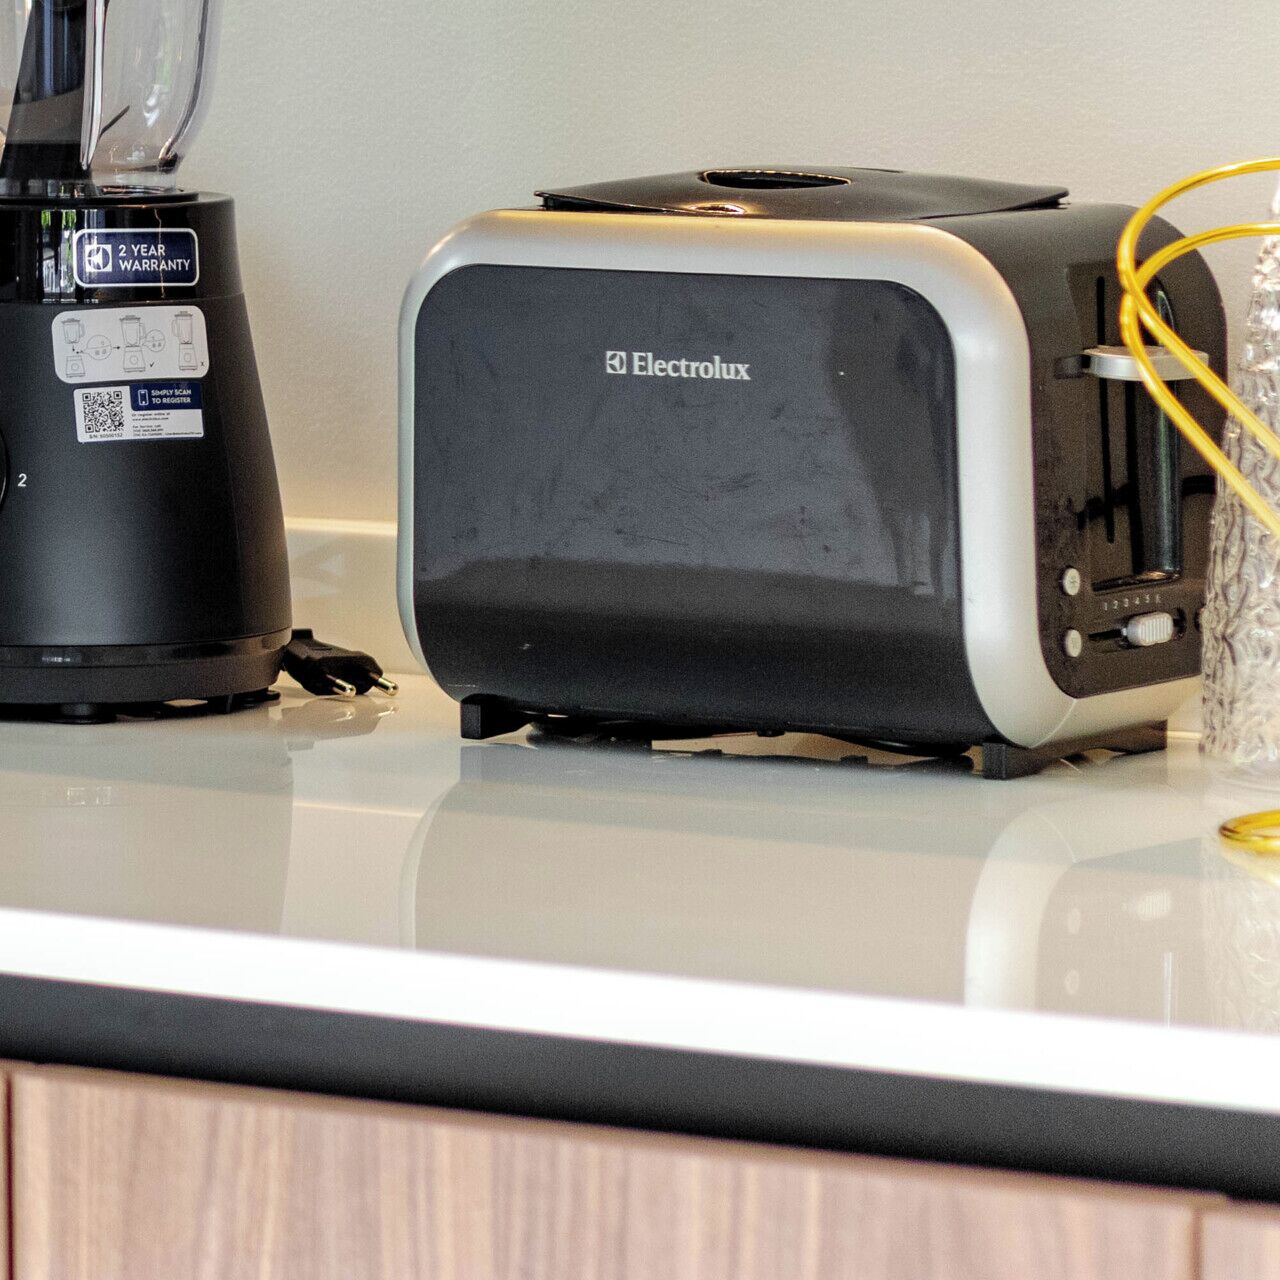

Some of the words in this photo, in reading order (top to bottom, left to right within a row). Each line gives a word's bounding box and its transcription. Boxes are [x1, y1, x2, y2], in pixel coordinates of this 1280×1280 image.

[119, 244, 127, 257] 2
[131, 244, 166, 257] YEAR
[119, 259, 190, 271] WARRANTY
[632, 352, 751, 380] Electrolux
[17, 473, 27, 487] 2
